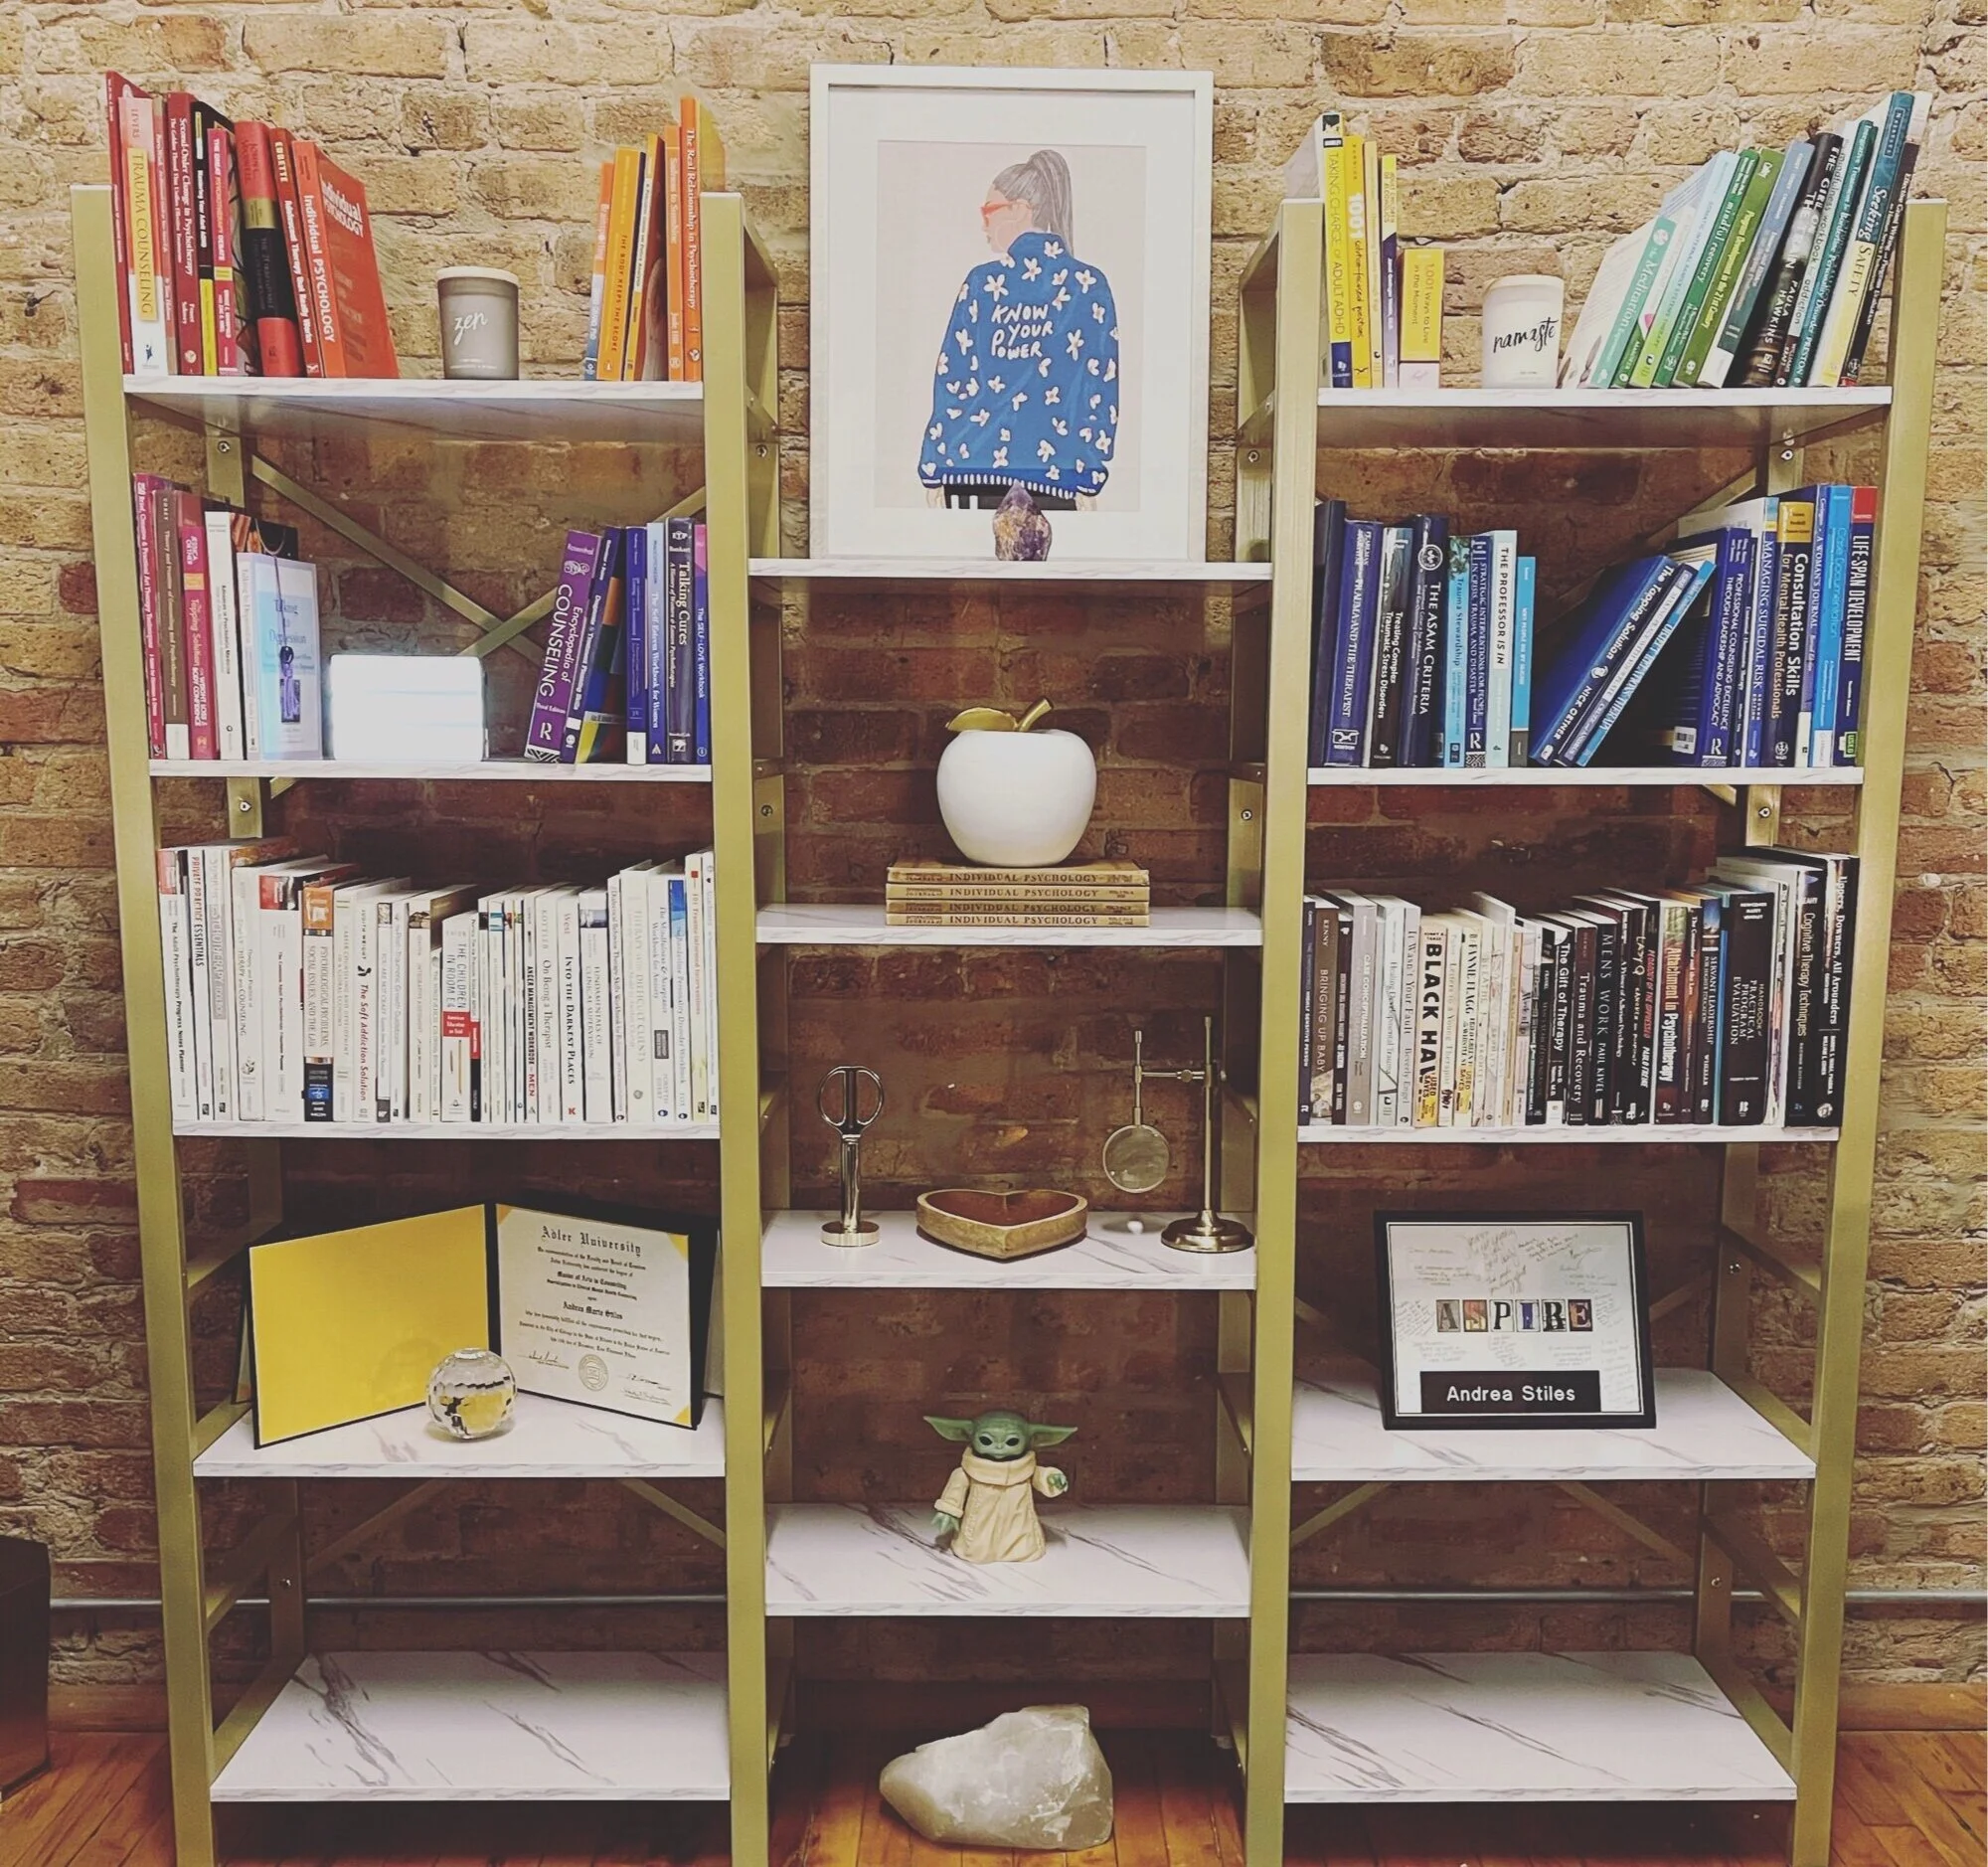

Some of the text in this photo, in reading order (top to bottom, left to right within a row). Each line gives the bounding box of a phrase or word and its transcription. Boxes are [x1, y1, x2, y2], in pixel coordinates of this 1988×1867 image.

[130, 108, 140, 138] LEVERS
[1825, 146, 1840, 171] THE
[179, 117, 195, 275] Second-Order Change in Psychotherapy
[686, 128, 697, 309] The Real Relationship in Psychotherapy
[1813, 177, 1832, 210] GIRL
[1859, 185, 1889, 241] Seeking
[131, 153, 153, 314] TRAUMA COUNSELING
[1715, 202, 1735, 241] mindful
[1784, 191, 1817, 268] THE TRAIN
[303, 195, 322, 254] Individual
[313, 258, 335, 342] PSYCHOLOGY
[1698, 242, 1721, 284] recovery
[1847, 246, 1873, 297] SAFETY
[615, 278, 624, 305] KEEPS
[991, 302, 1049, 324] KNOW
[1421, 292, 1430, 314] Ways
[1764, 290, 1787, 344] HAWKINS
[1782, 279, 1799, 317] PAULA
[453, 312, 488, 346] zen
[611, 325, 620, 351] SCORE
[991, 329, 1043, 360] POWER
[1008, 321, 1053, 346] YOUR
[1423, 316, 1430, 325] to
[1493, 316, 1559, 353] namaste
[677, 562, 690, 645] Talking Cures
[1453, 578, 1464, 666] Trauma Stewardship
[1497, 547, 1509, 664] THE PROFESSOR IS IN
[1605, 566, 1674, 660] The Tapping Solution
[1723, 576, 1734, 616] THROUGH
[1752, 541, 1773, 689] MANAGING SUICIDAL RISK
[1844, 535, 1870, 663] LIFE-SPAN DEVELOPMENT
[540, 584, 573, 698] COUNSELING
[561, 606, 582, 683] Encyclopedia of
[1390, 611, 1404, 684] Treating Complex
[1418, 583, 1441, 714] THE ASAM CRITERIA
[1719, 617, 1729, 660] LEADERSHIP
[1771, 553, 1791, 719] for Mental Health Professionals
[1785, 553, 1808, 696] Consultation Skills
[1378, 611, 1393, 719] Traumatic Stress Disorders
[1721, 573, 1743, 731] PROFESSIONAL COUNSELING EXCELLENCE
[1554, 687, 1592, 741] NICK ORTNER
[1711, 681, 1722, 727] ADVOCACY
[949, 873, 1098, 883] INDIVIDUAL PSYCHOLOGY
[949, 889, 1098, 898] INDIVIDUAL PSYCHOLOGY
[191, 856, 204, 966] PRIVATE PRACTICE ESSENTIALS
[949, 903, 1098, 912] INDIVIDUAL PSYCHOLOGY
[1024, 916, 1098, 925] PSYCHOLOGY
[446, 954, 455, 965] IN
[456, 942, 467, 1009] THE CHILDREN
[565, 956, 574, 980] INTO
[1796, 913, 1815, 1036] Cognitive Therapy Techniques
[1830, 876, 1848, 1024] Uppers, Downers, All Arounders
[360, 984, 369, 1000] The
[446, 967, 455, 994] ROOM
[1404, 931, 1416, 1035] It Wasn't Your Fault
[1422, 943, 1442, 1020] BLACK
[1553, 942, 1571, 1051] The Gift of Therapy
[360, 1002, 369, 1020] Soft
[566, 1004, 575, 1048] DARKEST
[1316, 968, 1328, 1072] BRINGING UP BABY
[1594, 934, 1613, 1094] MEN'S WORK PAUL KIVEL
[1659, 947, 1682, 1082] Attachment in Psychotherapy
[1730, 976, 1740, 1045] EVALUATION
[1739, 984, 1749, 1037] PROGRAM
[1746, 979, 1757, 1041] PRACTICAL
[360, 1023, 369, 1064] Addiction
[1573, 972, 1589, 1103] Trauma and Recovery
[1402, 1047, 1411, 1104] Beverly Engel
[541, 1225, 641, 1258] Adler University
[1435, 1299, 1592, 1332] ASPIRE
[1446, 1385, 1575, 1402] Andrea Stiles
